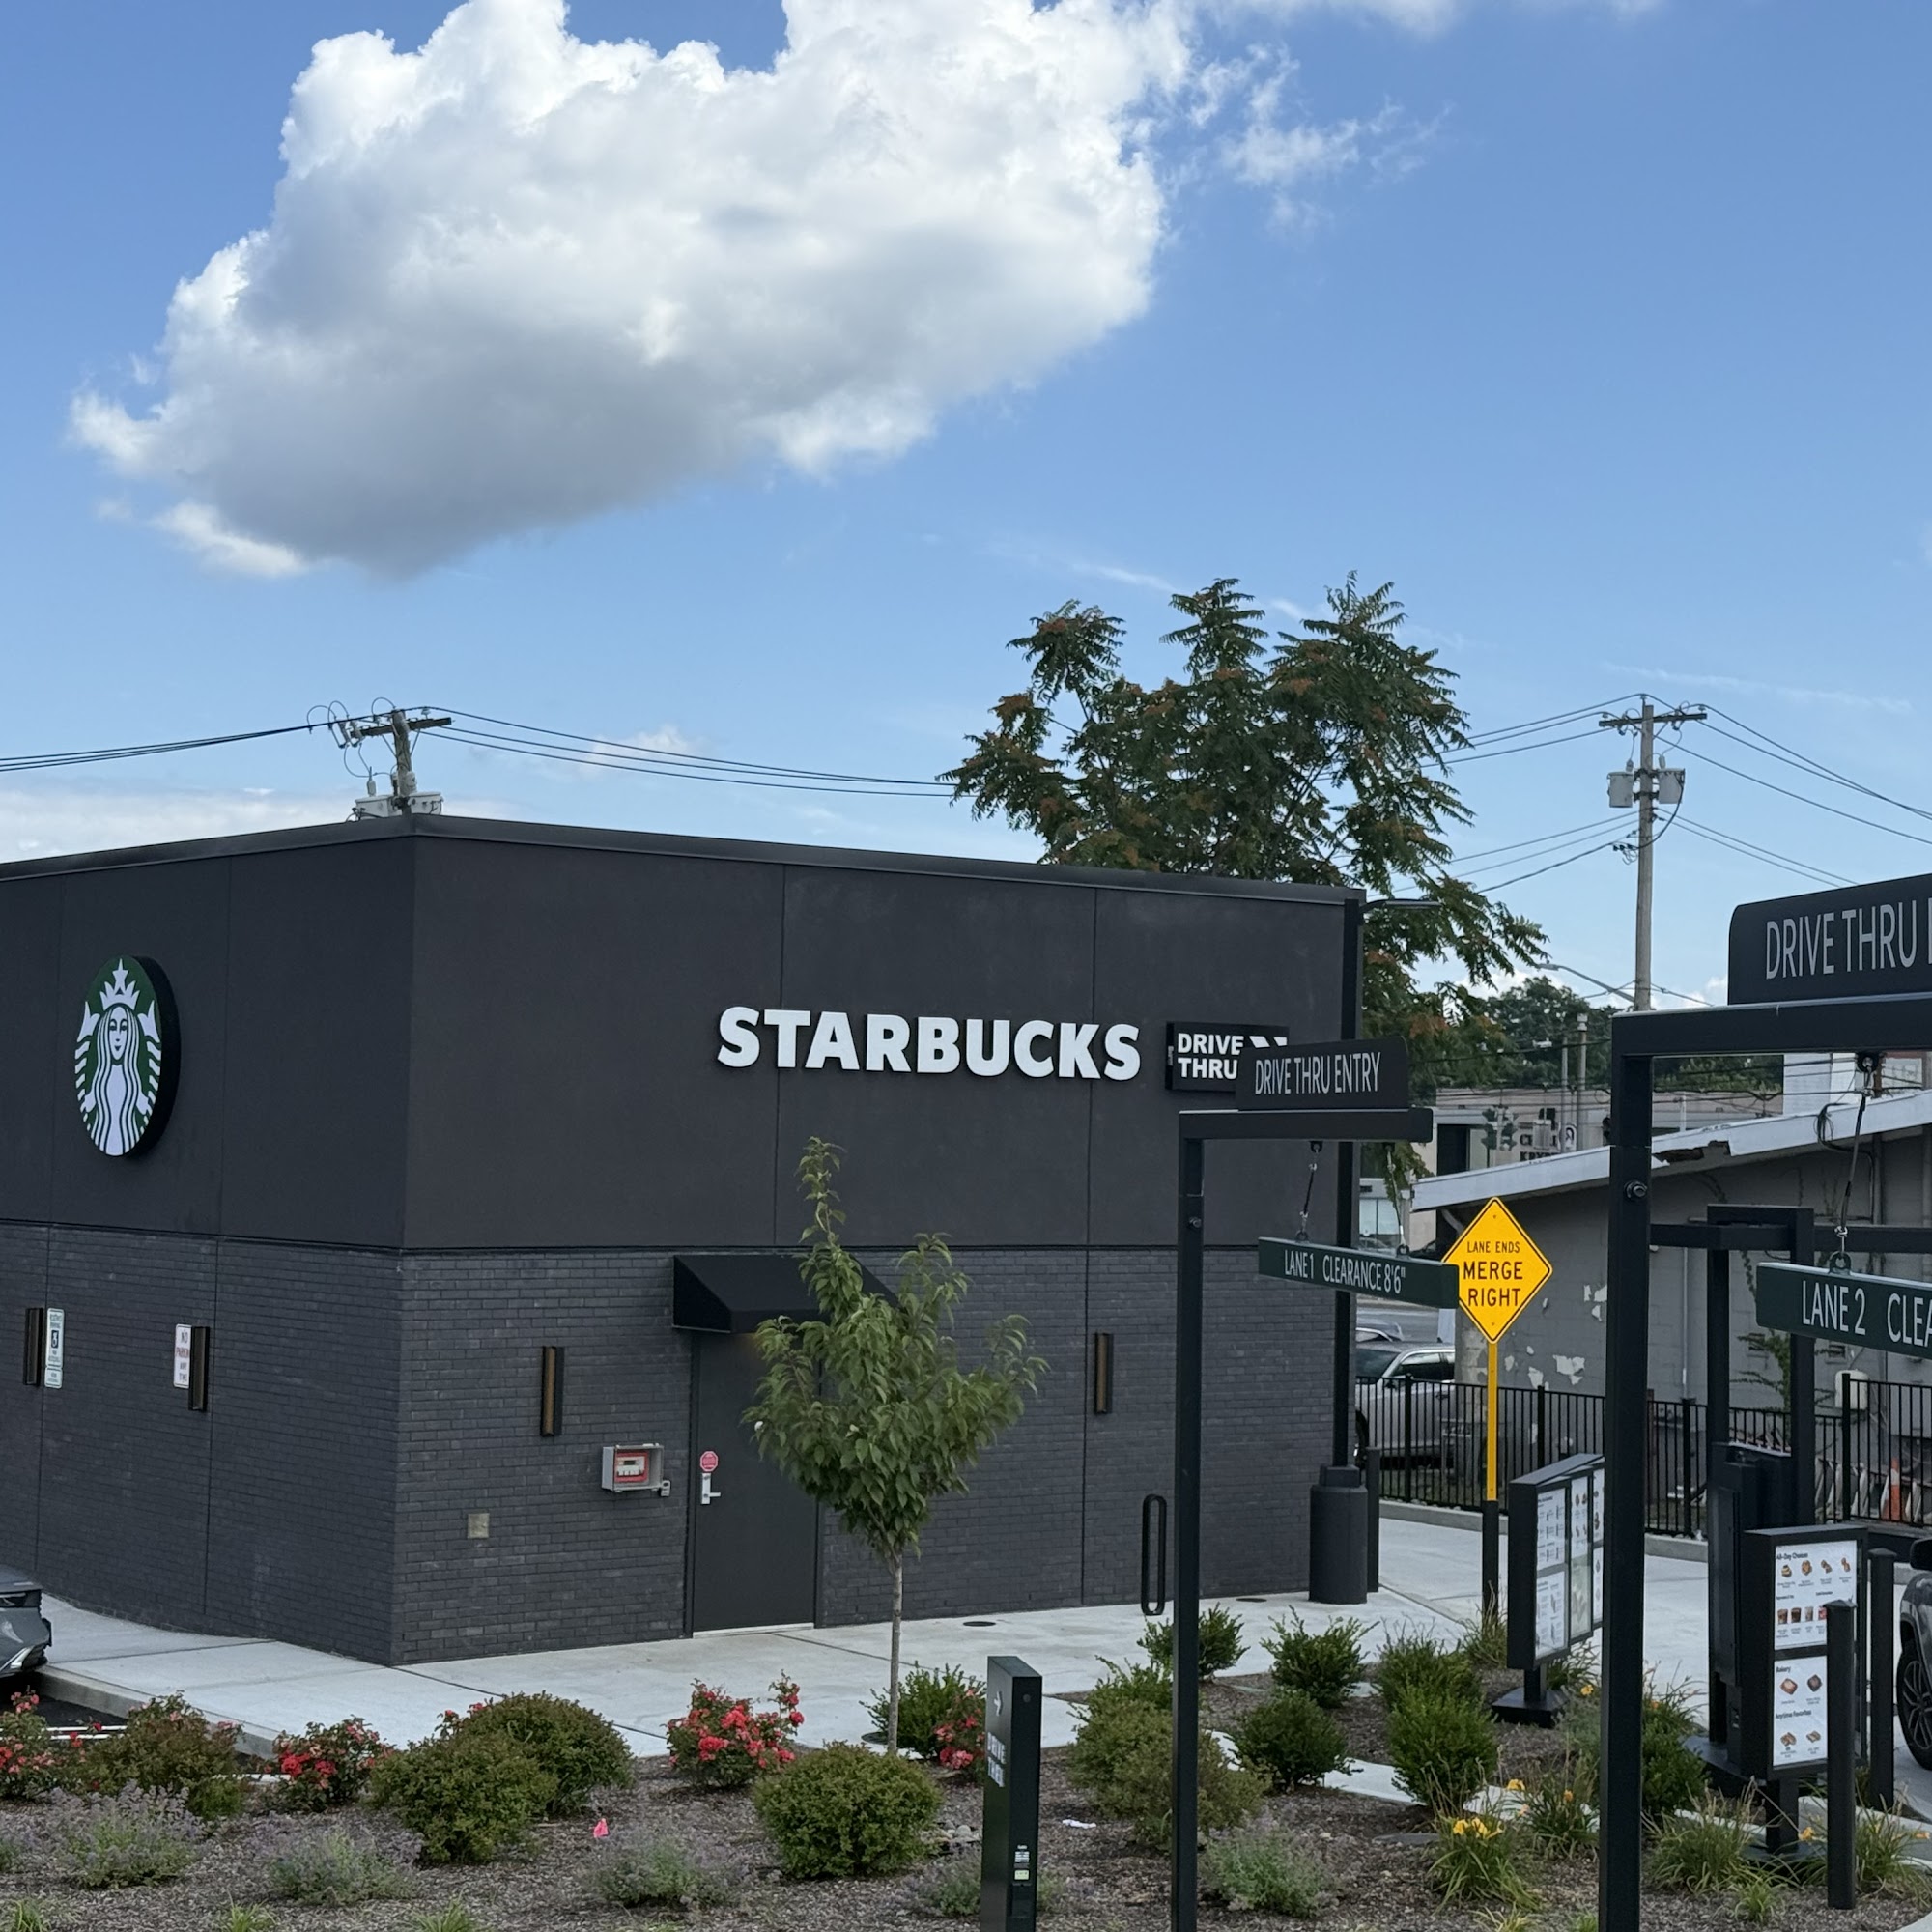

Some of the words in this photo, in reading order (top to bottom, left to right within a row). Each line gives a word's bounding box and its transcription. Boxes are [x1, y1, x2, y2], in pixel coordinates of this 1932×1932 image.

[1766, 912, 1835, 980] DRIVE
[1841, 899, 1918, 971] THRU
[717, 1006, 1141, 1081] STARBUCKS
[1178, 1033, 1244, 1055] DRIVE
[1177, 1057, 1237, 1080] THRU
[1255, 1058, 1292, 1095] DRIVE
[1293, 1055, 1331, 1094] THRU
[1334, 1051, 1381, 1094] ENTRY
[1467, 1241, 1491, 1253] LANE
[1495, 1241, 1520, 1253] ENDS
[1285, 1249, 1308, 1279] LANE
[1309, 1253, 1315, 1279] 1
[1322, 1255, 1382, 1291] CLEARANCE
[1383, 1264, 1406, 1294] 8'6"
[1463, 1261, 1523, 1280] MERGE
[1468, 1288, 1521, 1307] RIGHT
[1803, 1280, 1849, 1332] LANE
[1854, 1288, 1866, 1336] 2
